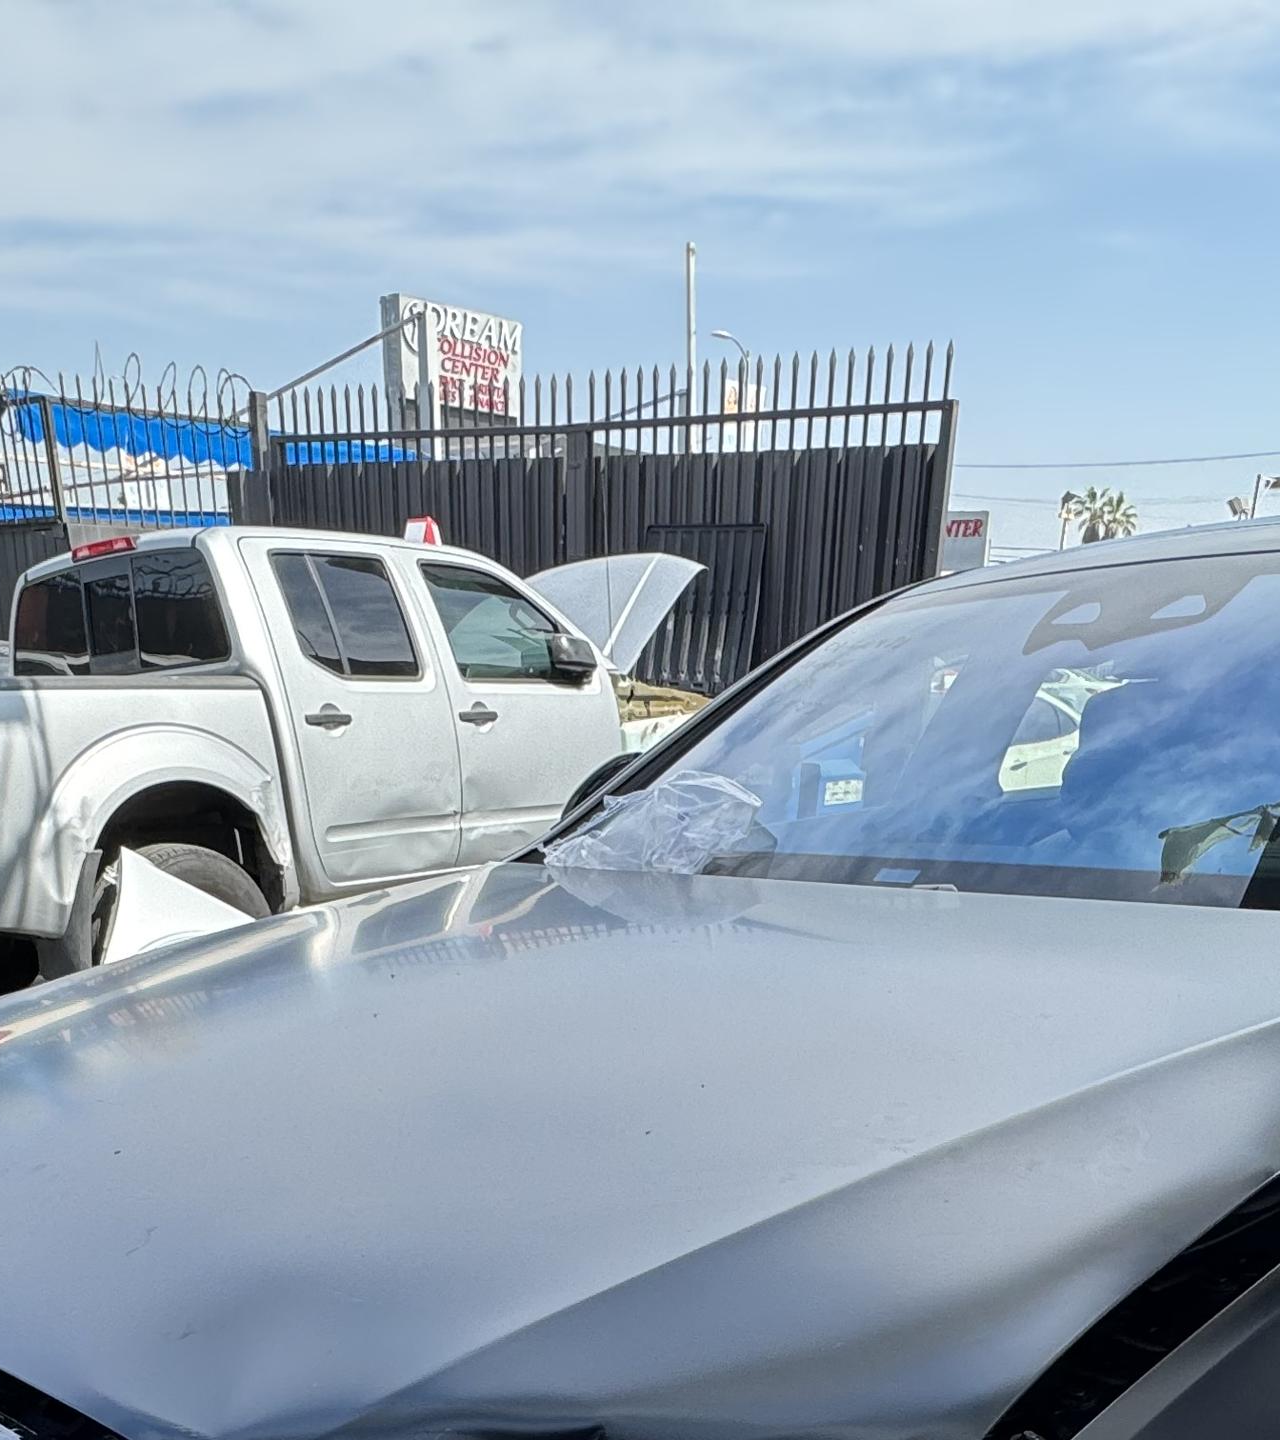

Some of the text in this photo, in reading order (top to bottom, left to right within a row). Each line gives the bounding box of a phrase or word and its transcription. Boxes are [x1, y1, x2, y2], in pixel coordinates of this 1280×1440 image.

[431, 301, 522, 354] DREAM
[437, 337, 509, 368] OLLISION
[441, 357, 500, 382] CENTER
